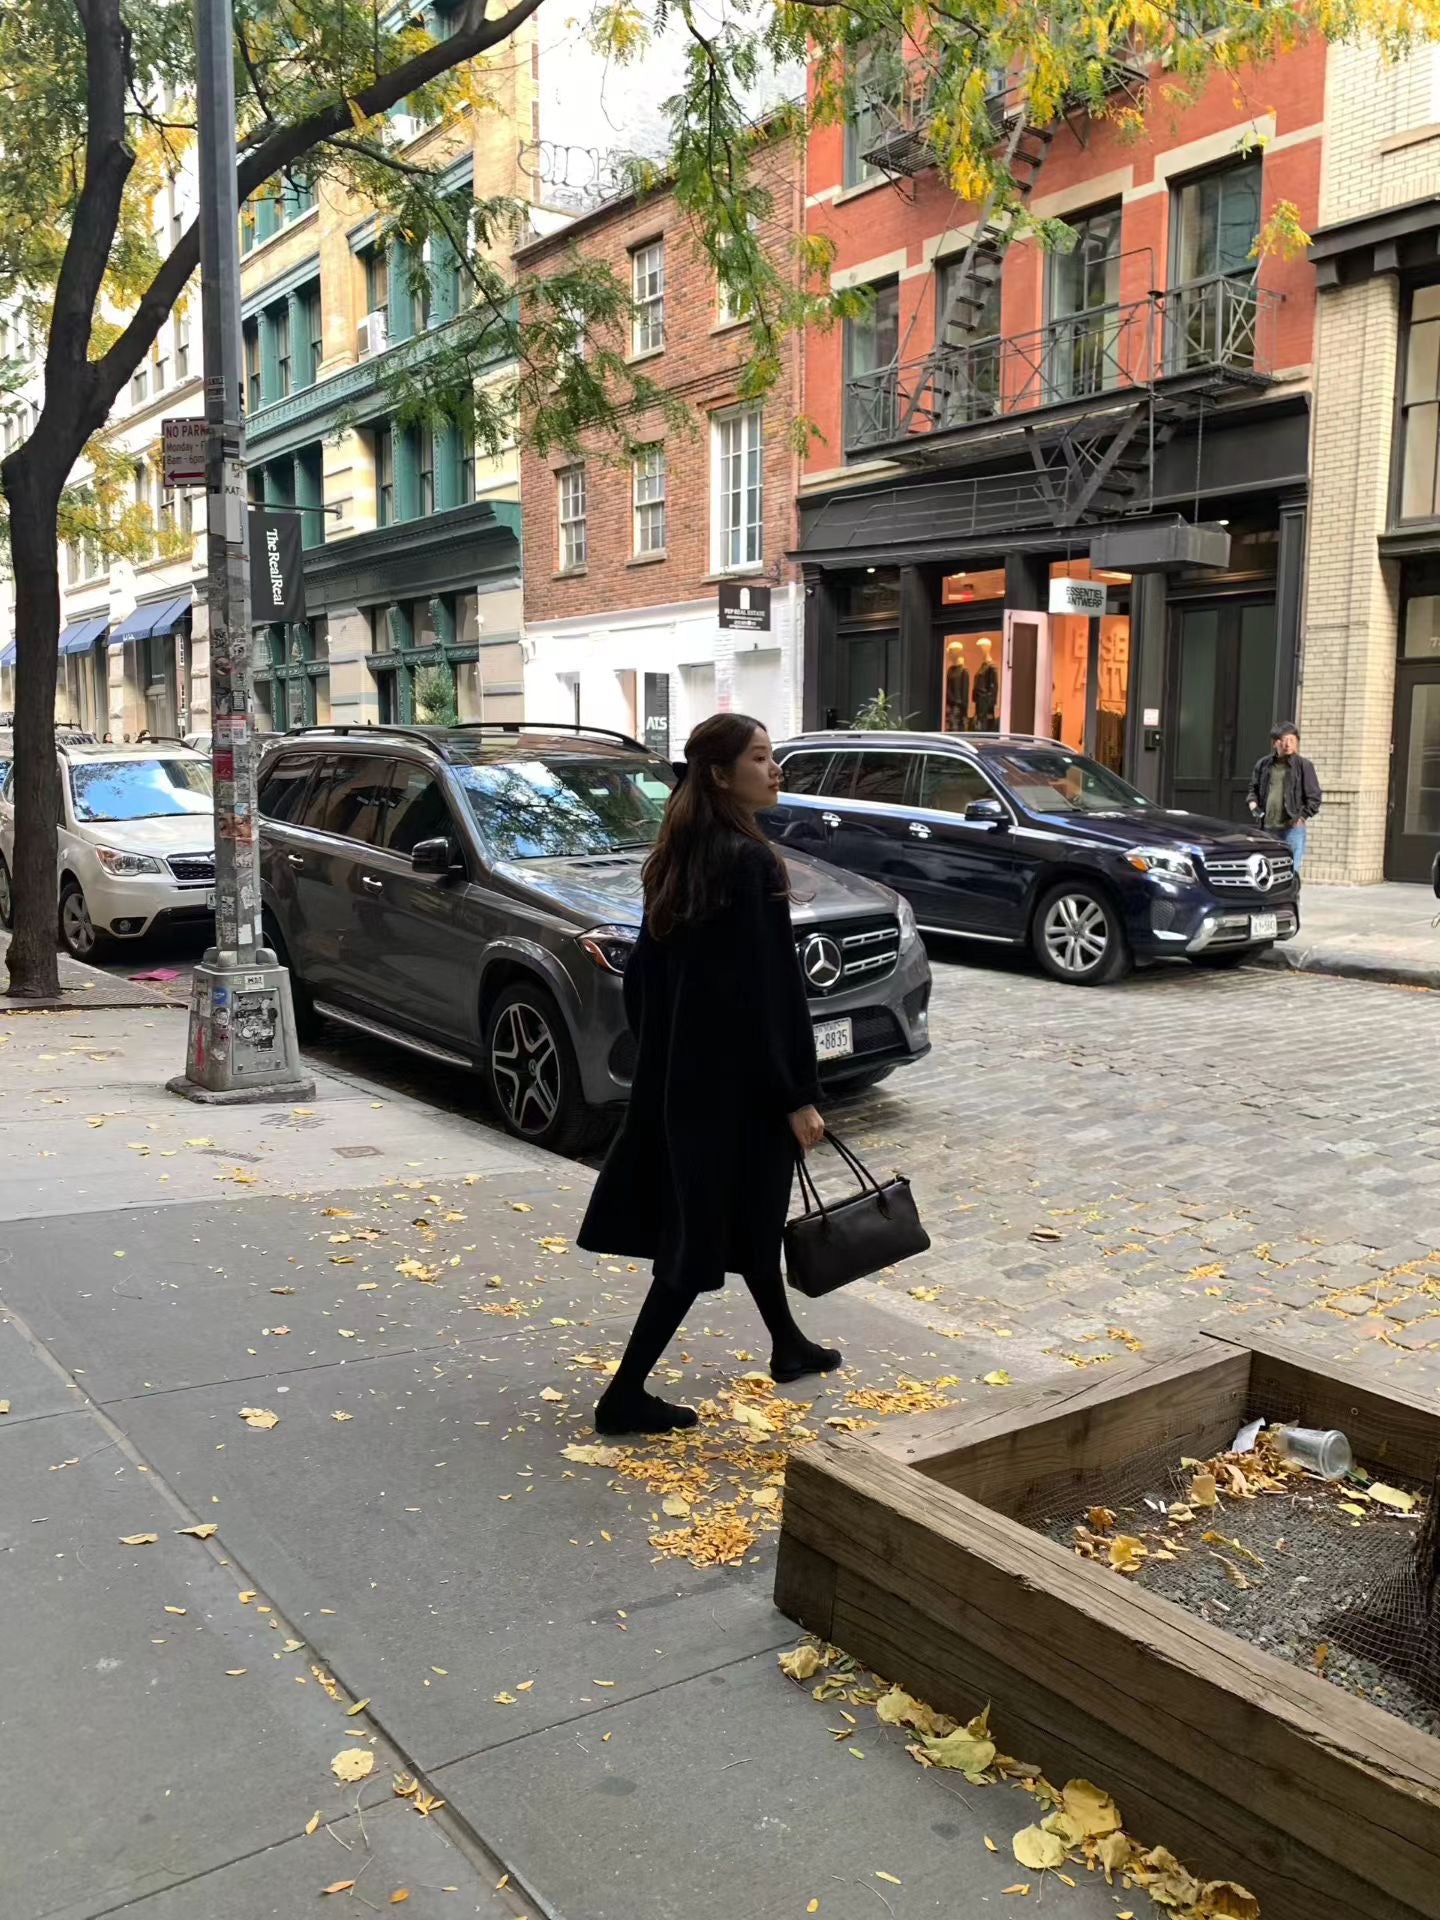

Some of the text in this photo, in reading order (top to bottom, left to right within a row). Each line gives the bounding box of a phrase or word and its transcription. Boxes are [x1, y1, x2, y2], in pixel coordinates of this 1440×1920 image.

[166, 425, 179, 439] NO
[167, 442, 193, 453] Monday
[266, 528, 285, 605] The RealReal
[1066, 586, 1104, 599] ESSENTIEL
[1067, 596, 1102, 608] ANTWERP
